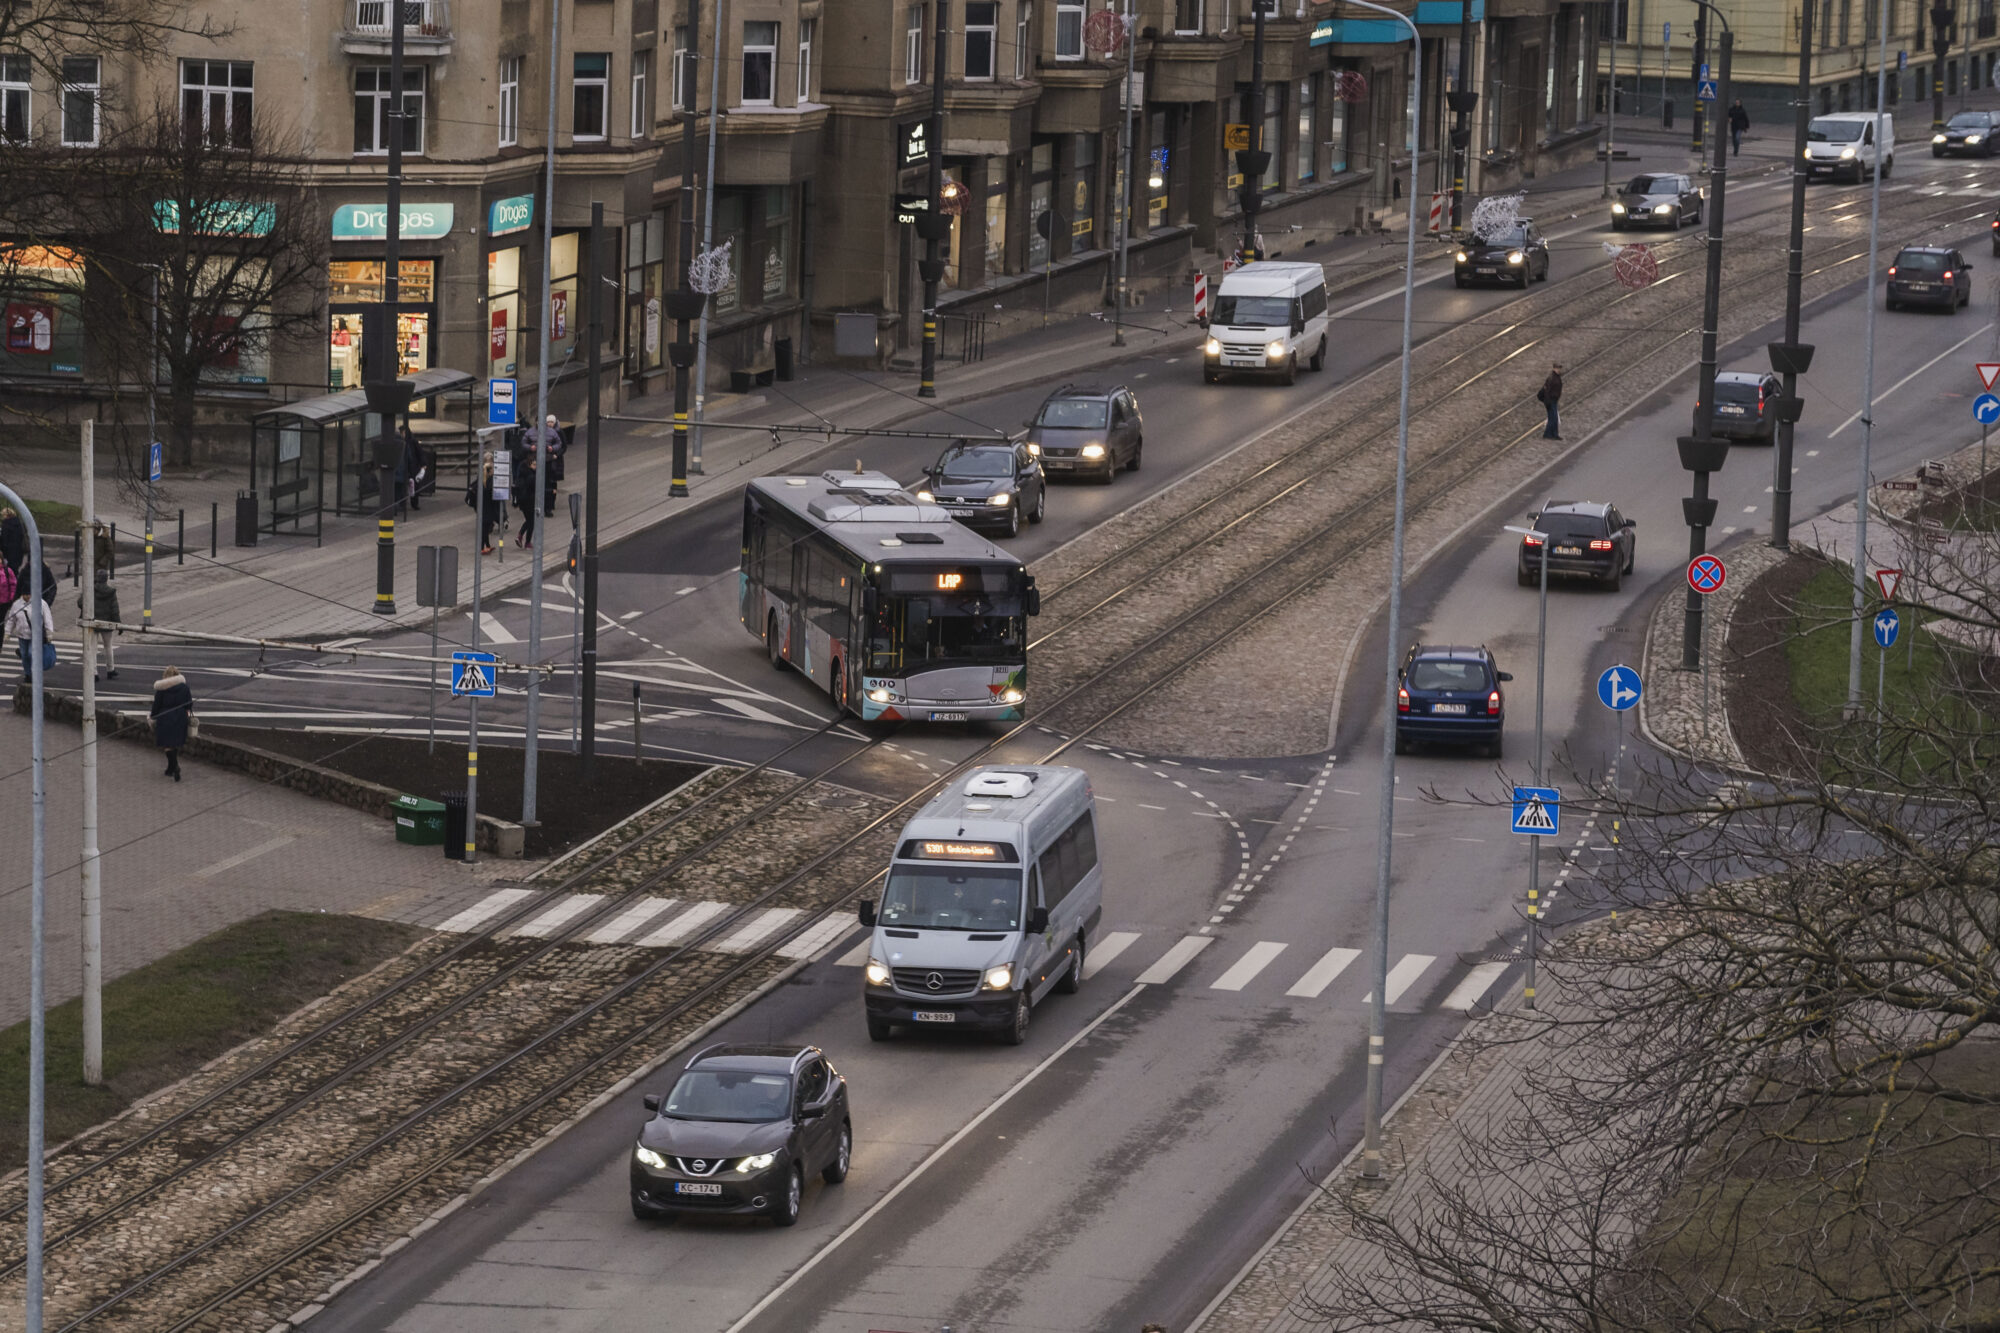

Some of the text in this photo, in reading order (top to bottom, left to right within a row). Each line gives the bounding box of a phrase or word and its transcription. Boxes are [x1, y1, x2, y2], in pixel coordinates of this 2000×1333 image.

[499, 203, 528, 224] Drogas
[938, 573, 962, 588] LAP
[680, 1184, 721, 1193] KC-1741
